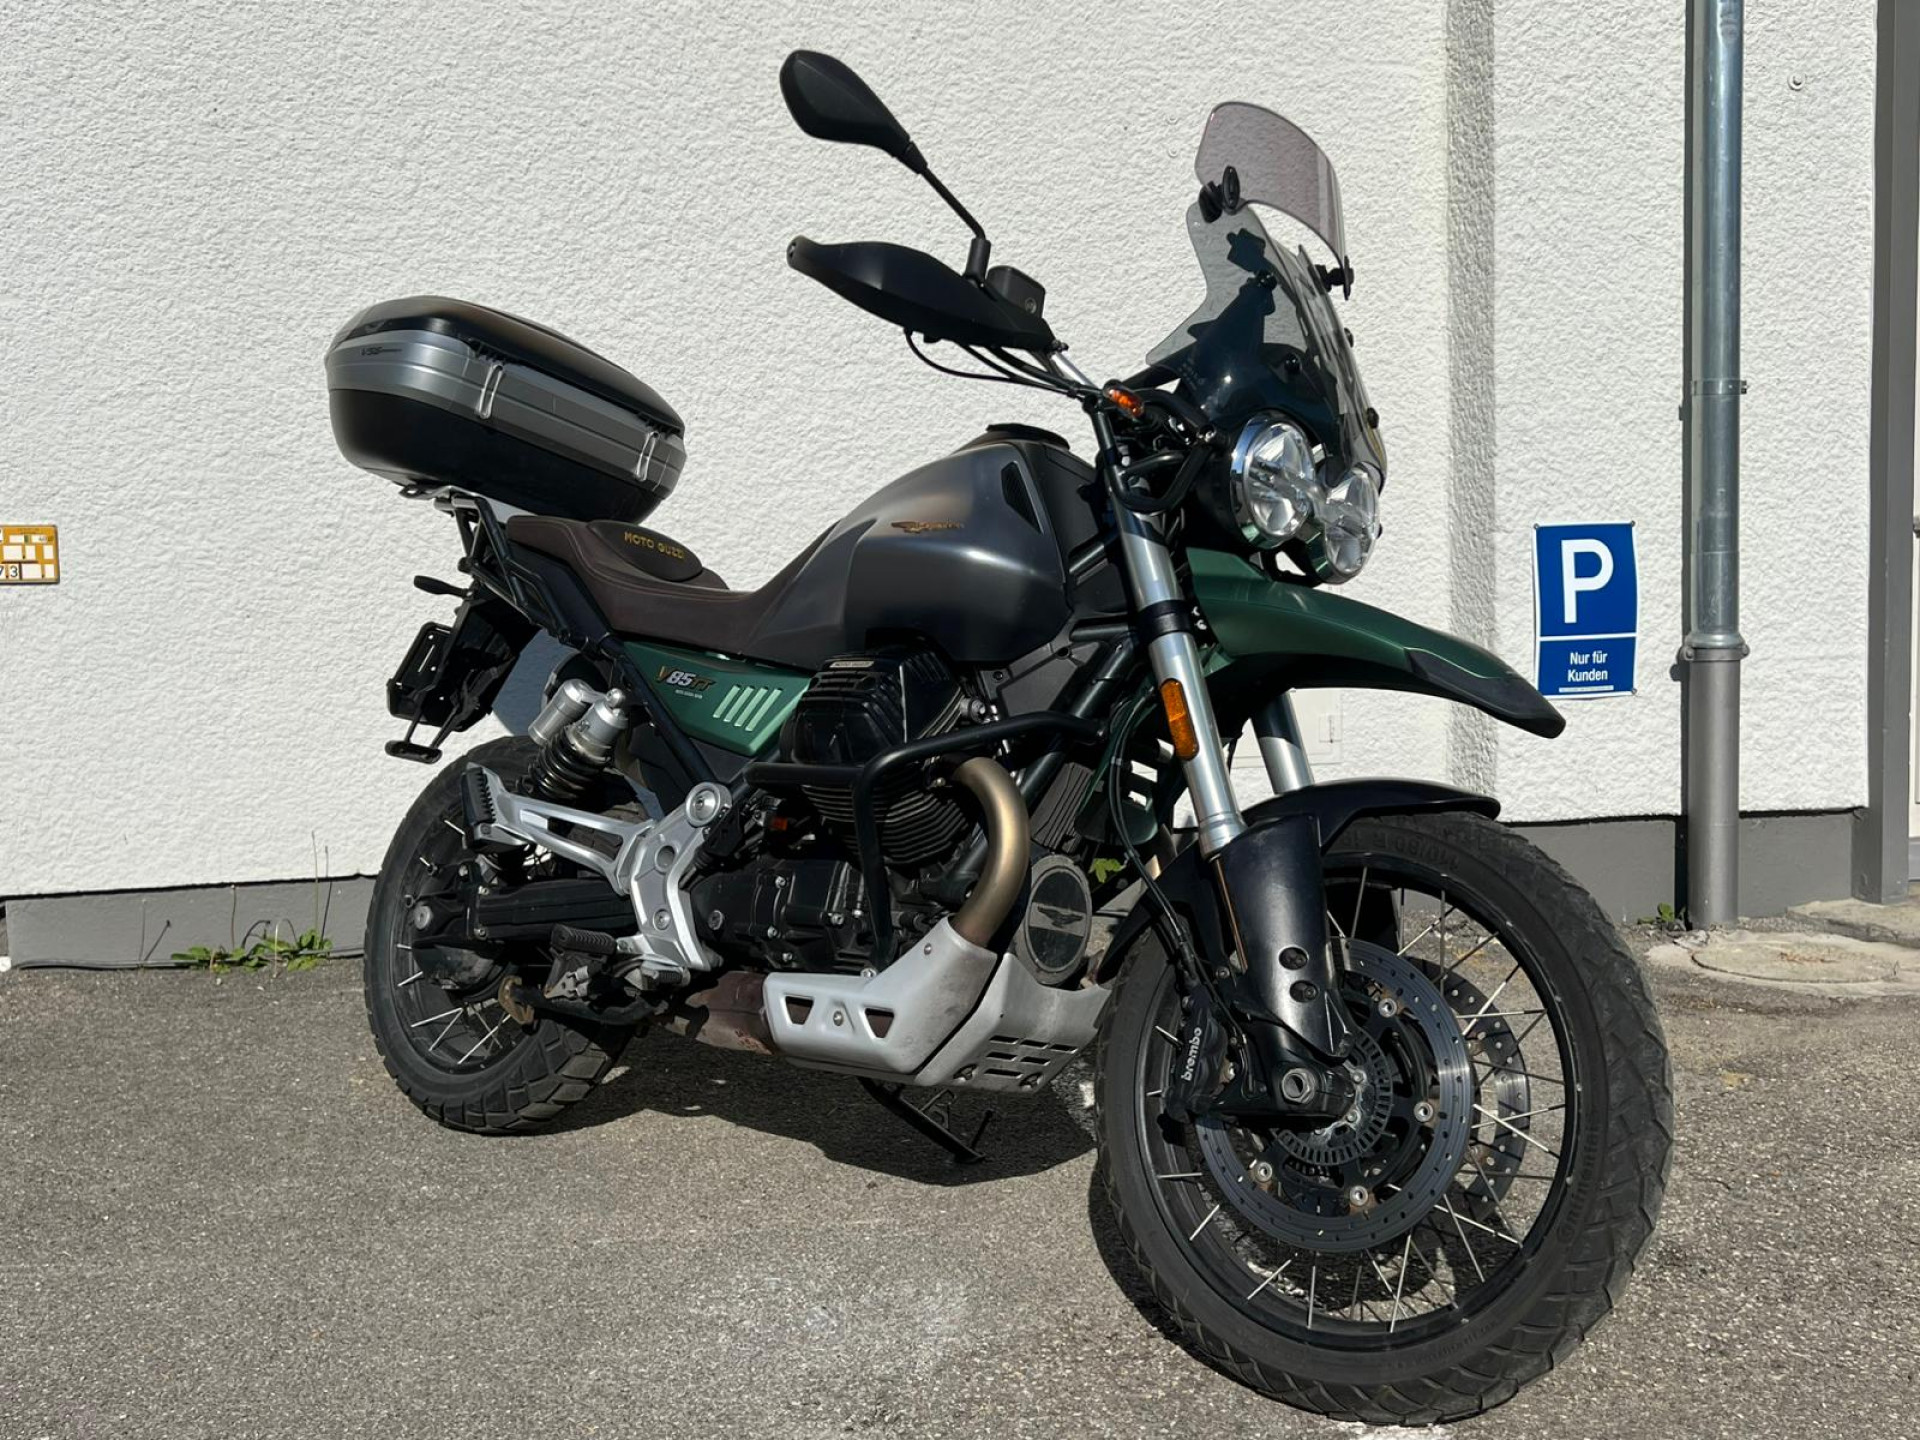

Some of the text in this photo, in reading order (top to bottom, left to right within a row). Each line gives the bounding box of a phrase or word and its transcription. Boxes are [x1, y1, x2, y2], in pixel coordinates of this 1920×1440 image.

[624, 531, 655, 549] MOTO
[1561, 538, 1614, 624] P
[1570, 650, 1608, 665] Nur für
[1567, 668, 1609, 682] Kunden
[1180, 1027, 1202, 1081] brembo
